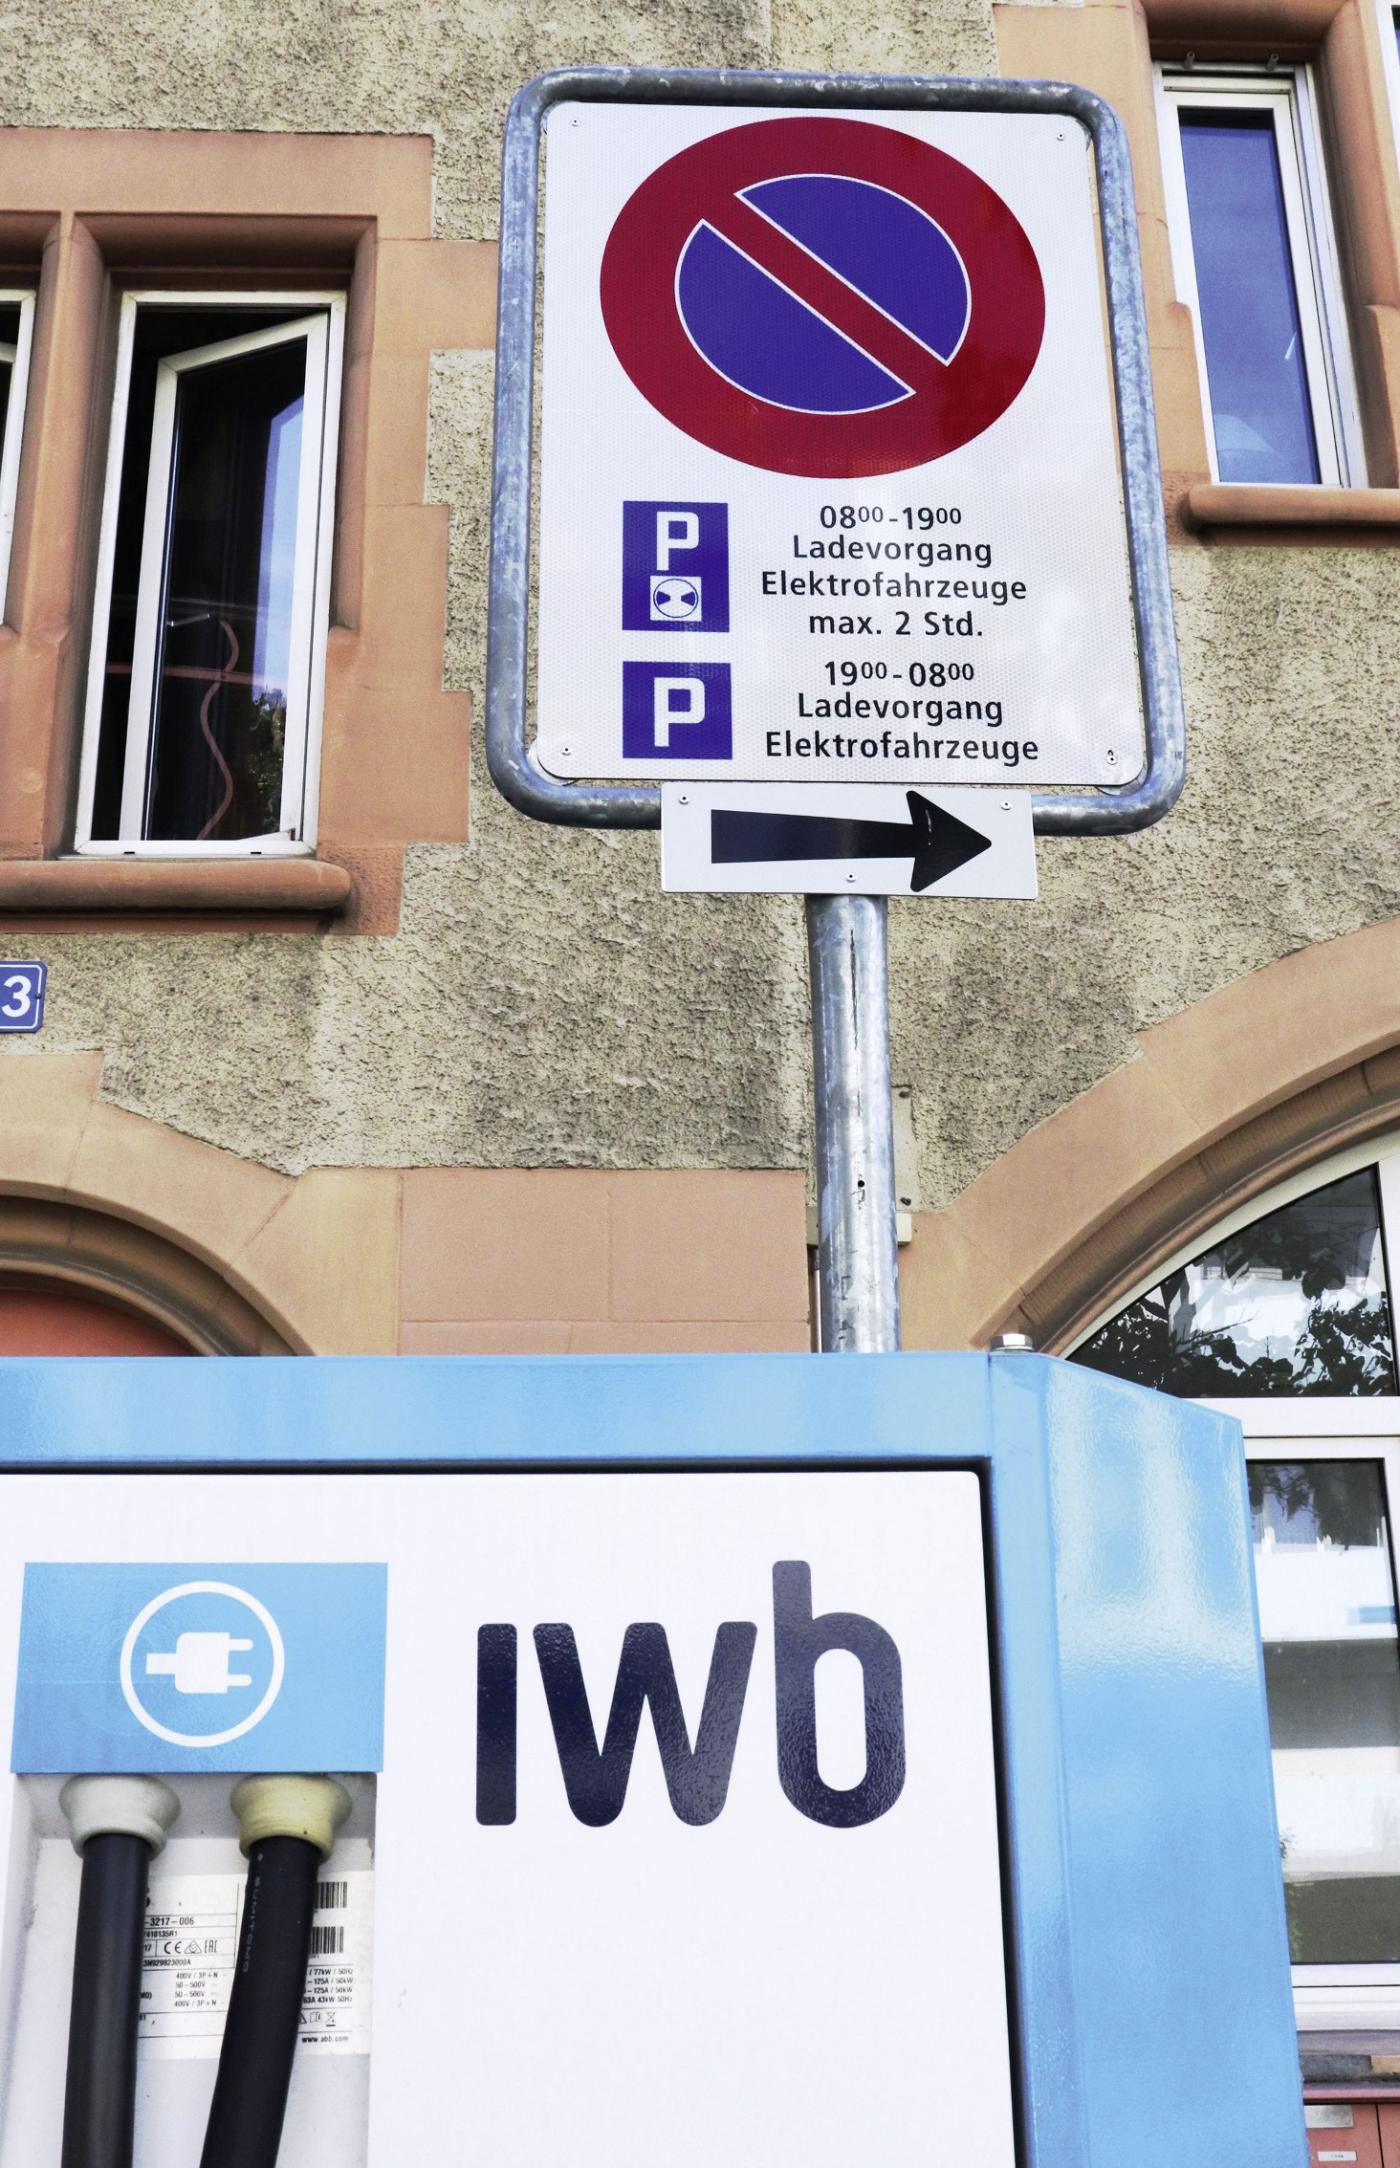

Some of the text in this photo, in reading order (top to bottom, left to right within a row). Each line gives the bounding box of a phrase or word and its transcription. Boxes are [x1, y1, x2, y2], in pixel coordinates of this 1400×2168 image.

[656, 511, 699, 571] P
[793, 534, 992, 568] Ladevorgang
[762, 571, 1027, 606] Elektrofahrzeuge
[809, 610, 983, 637] max. 2 Std.
[654, 677, 706, 747] P
[798, 692, 1002, 727] Ladevorgang
[766, 731, 1039, 767] Elektrofahrzeuge
[1, 975, 32, 1018] 3
[475, 1560, 906, 1828] iwb
